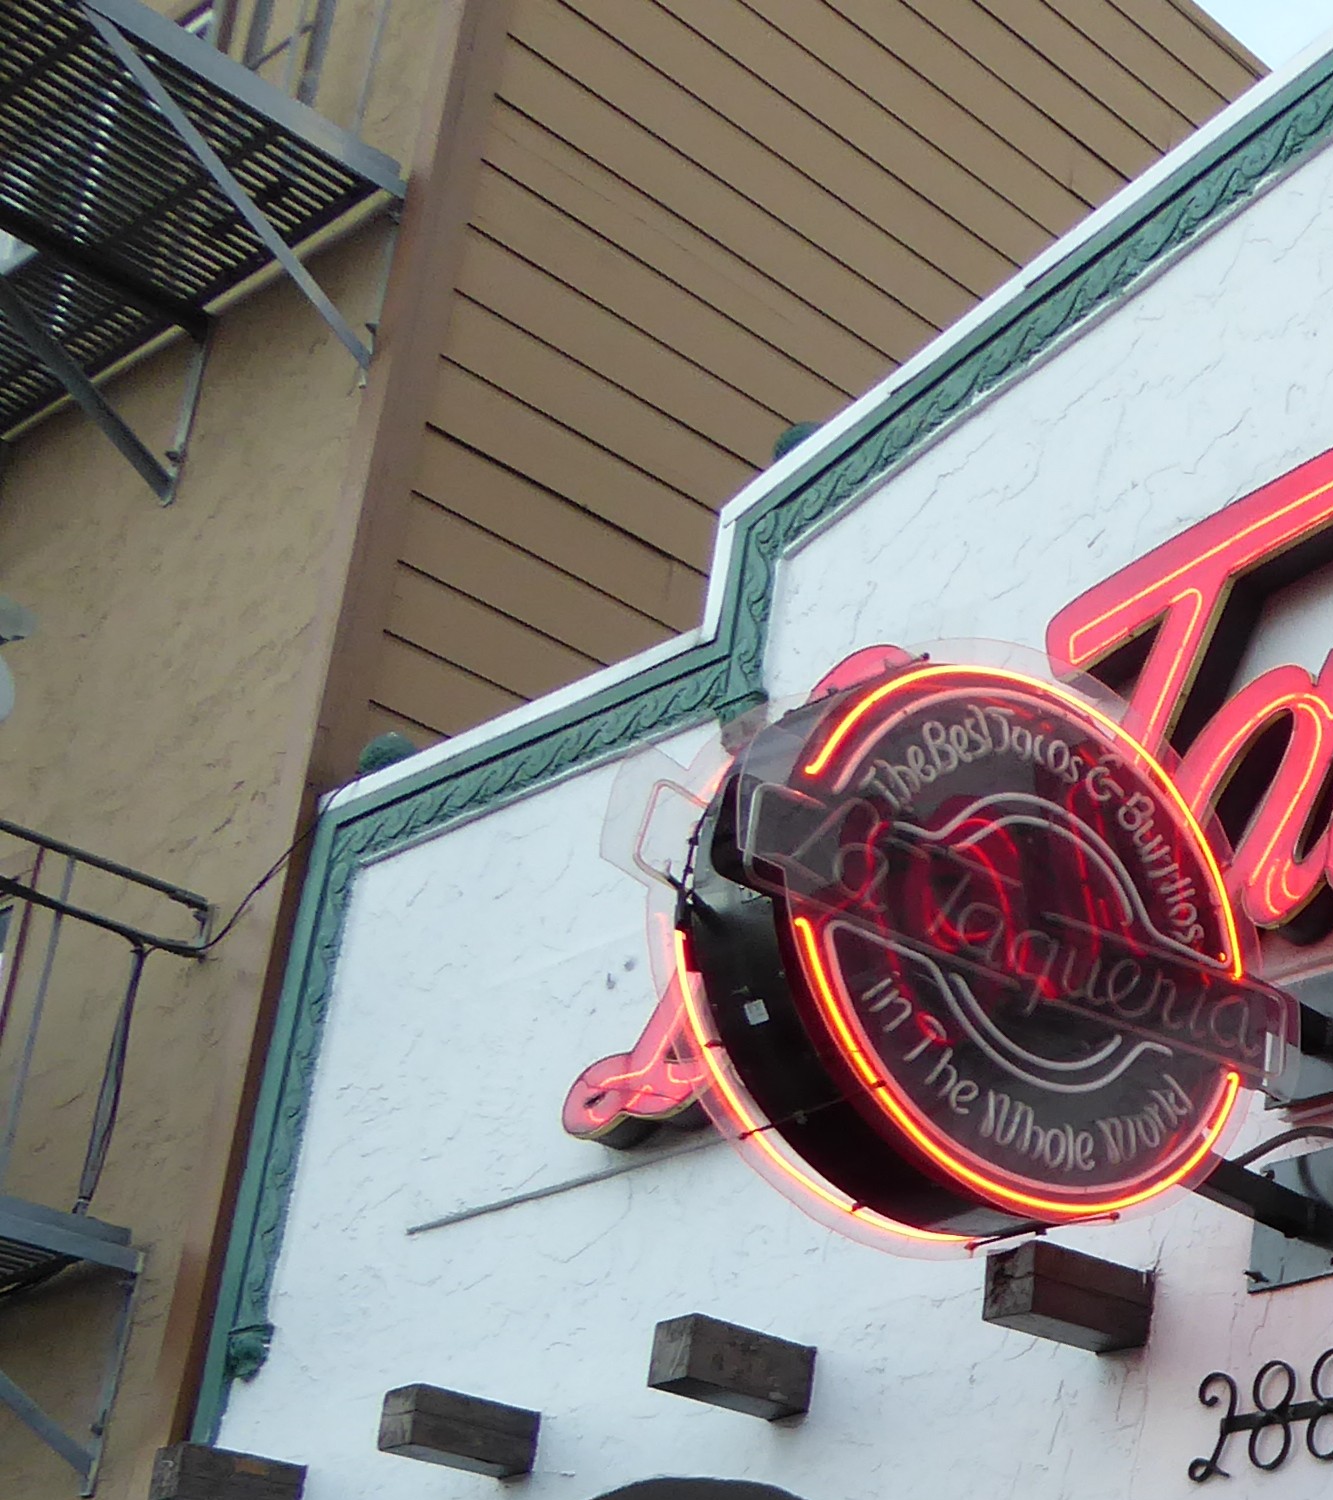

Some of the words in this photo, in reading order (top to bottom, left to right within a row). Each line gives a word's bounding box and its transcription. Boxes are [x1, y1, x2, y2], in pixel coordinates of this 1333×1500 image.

[848, 743, 937, 812] The
[920, 702, 993, 771] Best
[984, 704, 1084, 784] Tacos
[1116, 790, 1206, 944] Burritos
[903, 1013, 980, 1115] The
[978, 1087, 1096, 1172] Whole
[1093, 1073, 1194, 1165] World
